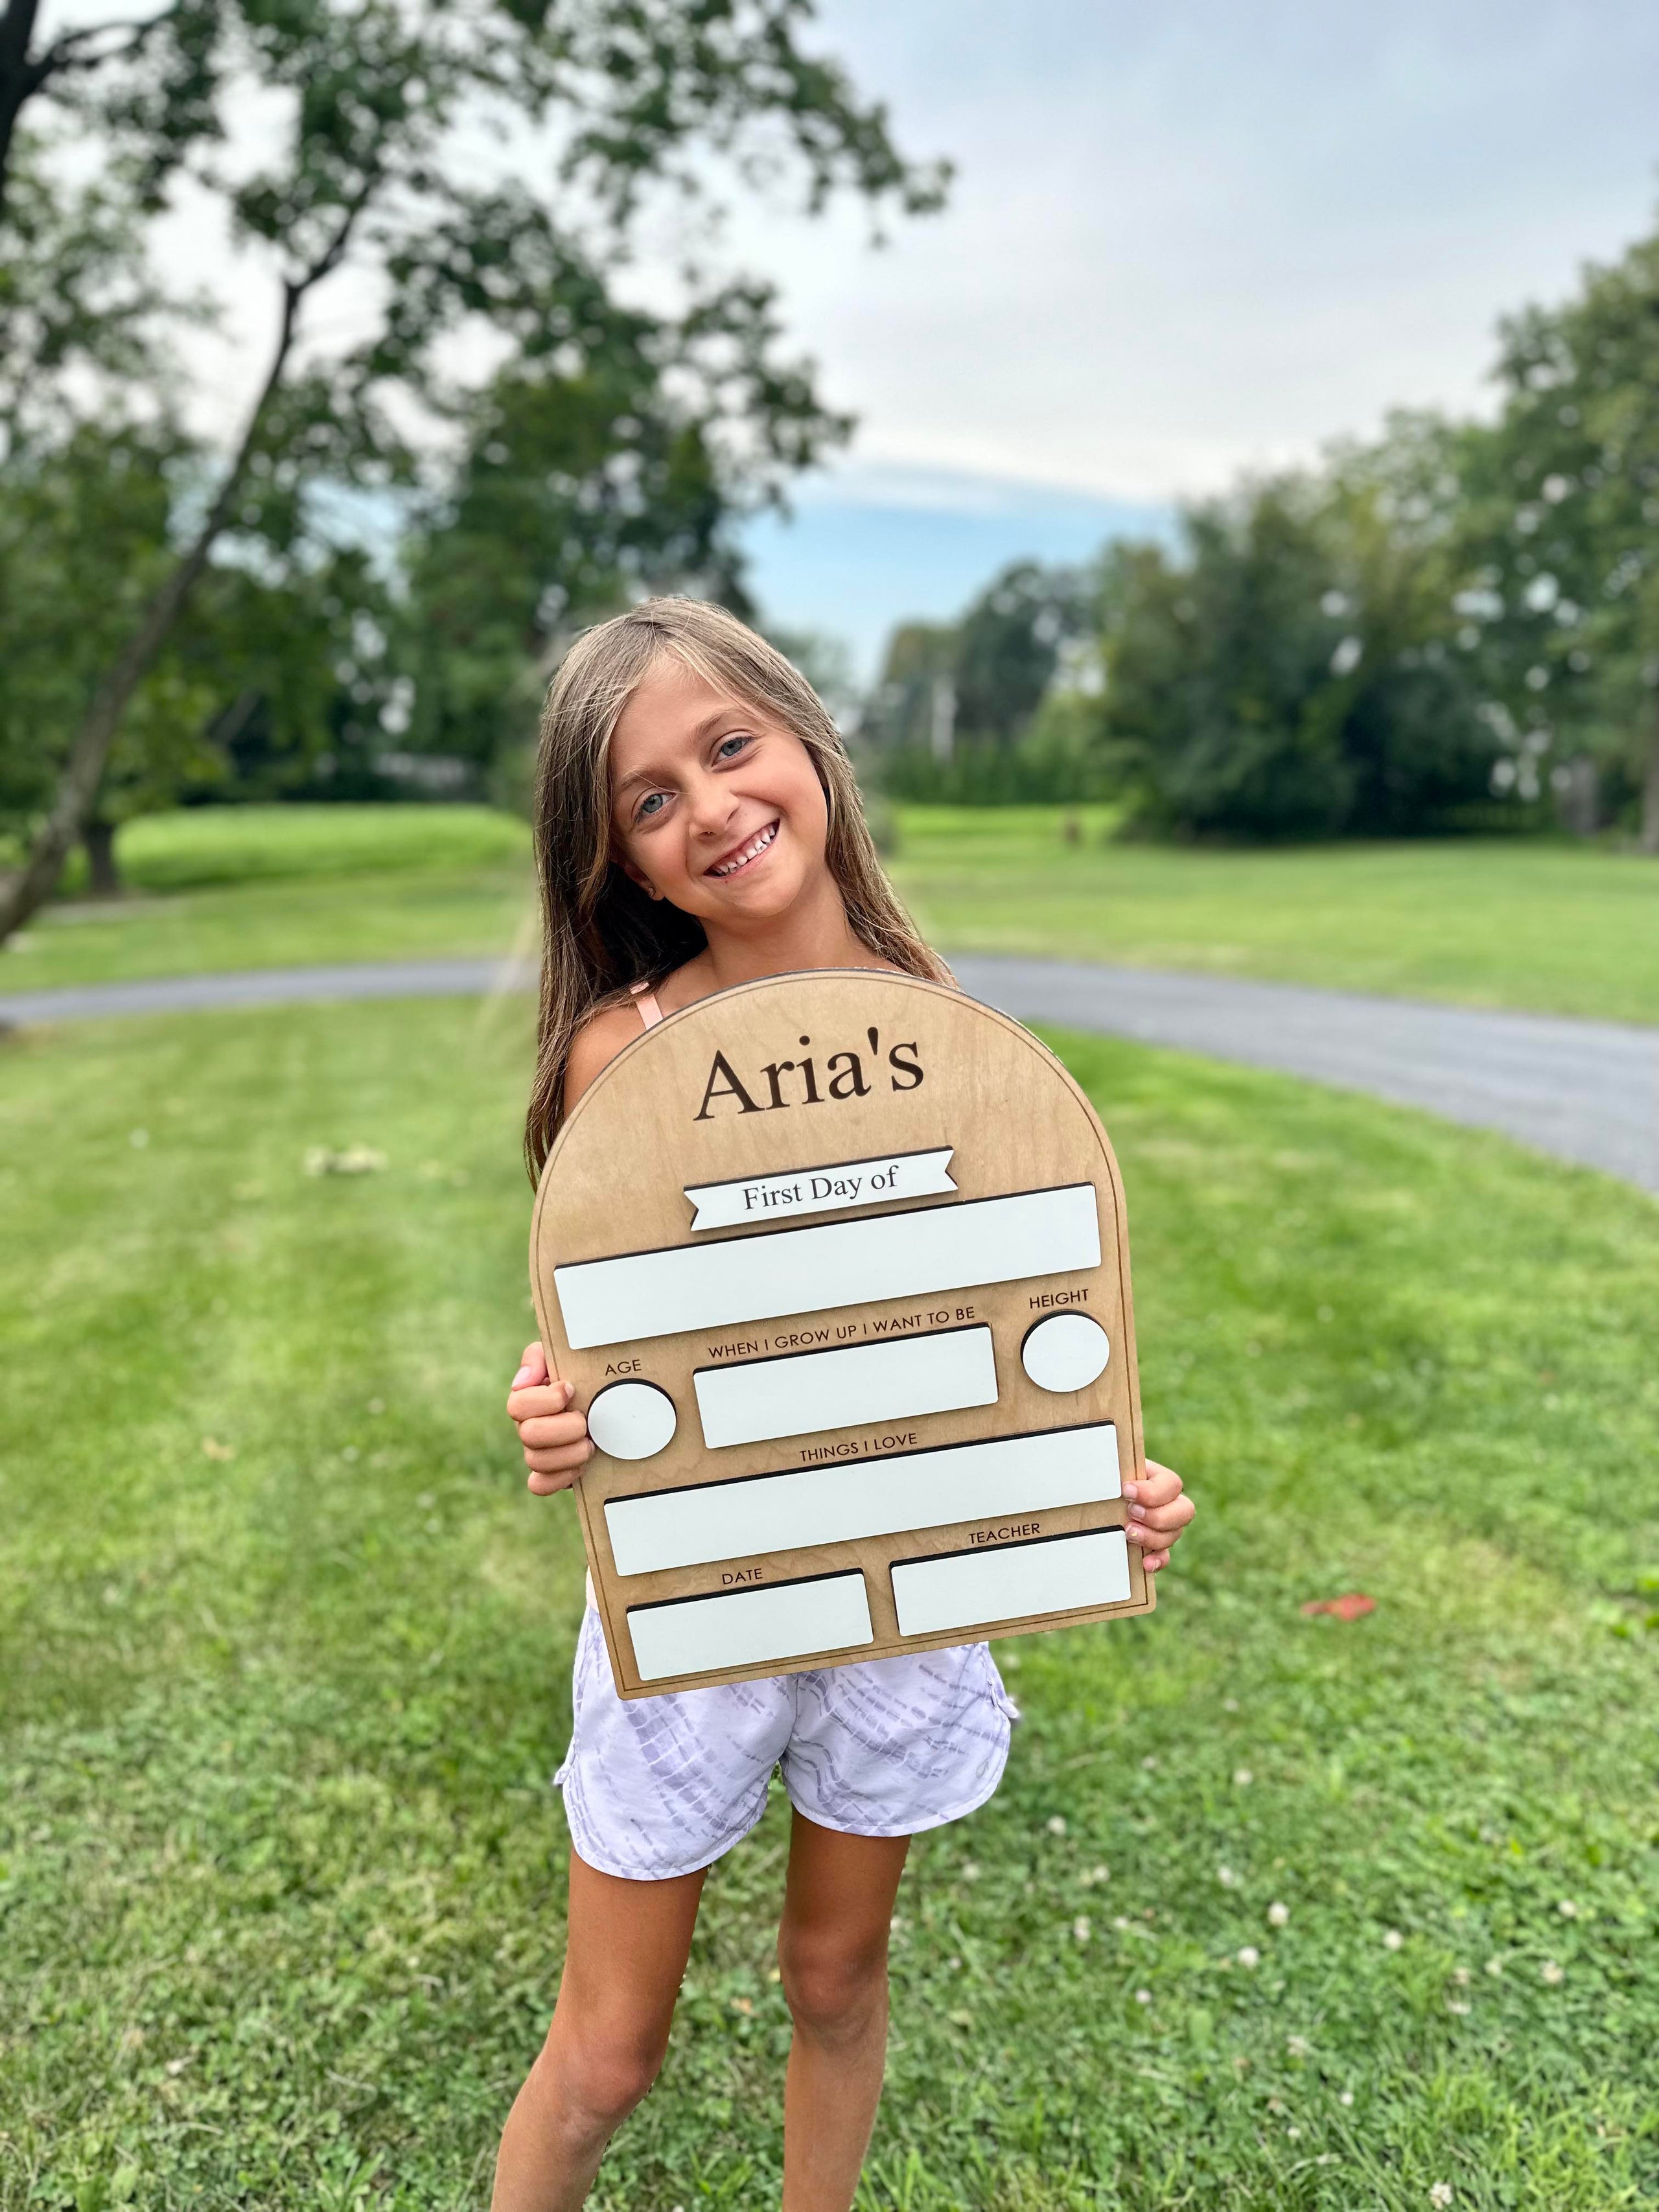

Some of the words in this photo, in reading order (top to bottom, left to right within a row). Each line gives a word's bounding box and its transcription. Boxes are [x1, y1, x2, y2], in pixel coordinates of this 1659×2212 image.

[693, 1027, 923, 1121] Aria's
[742, 1184, 802, 1209] First
[810, 1178, 862, 1199] Day
[871, 1165, 899, 1189] of
[1030, 1289, 1088, 1309] HEIGHT
[708, 1341, 758, 1358] WHEN
[764, 1338, 769, 1351] I
[775, 1329, 829, 1348] GROW
[837, 1325, 856, 1338] UP
[863, 1323, 867, 1335] I
[873, 1315, 921, 1333] WANT
[927, 1311, 949, 1324] TO
[956, 1307, 975, 1320] BE
[605, 1359, 641, 1376] AGE
[800, 1443, 858, 1461] THINGS
[864, 1440, 868, 1452] I
[874, 1433, 917, 1450] LOVE
[969, 1523, 1040, 1544] TEACHER
[722, 1568, 763, 1585] DATE
